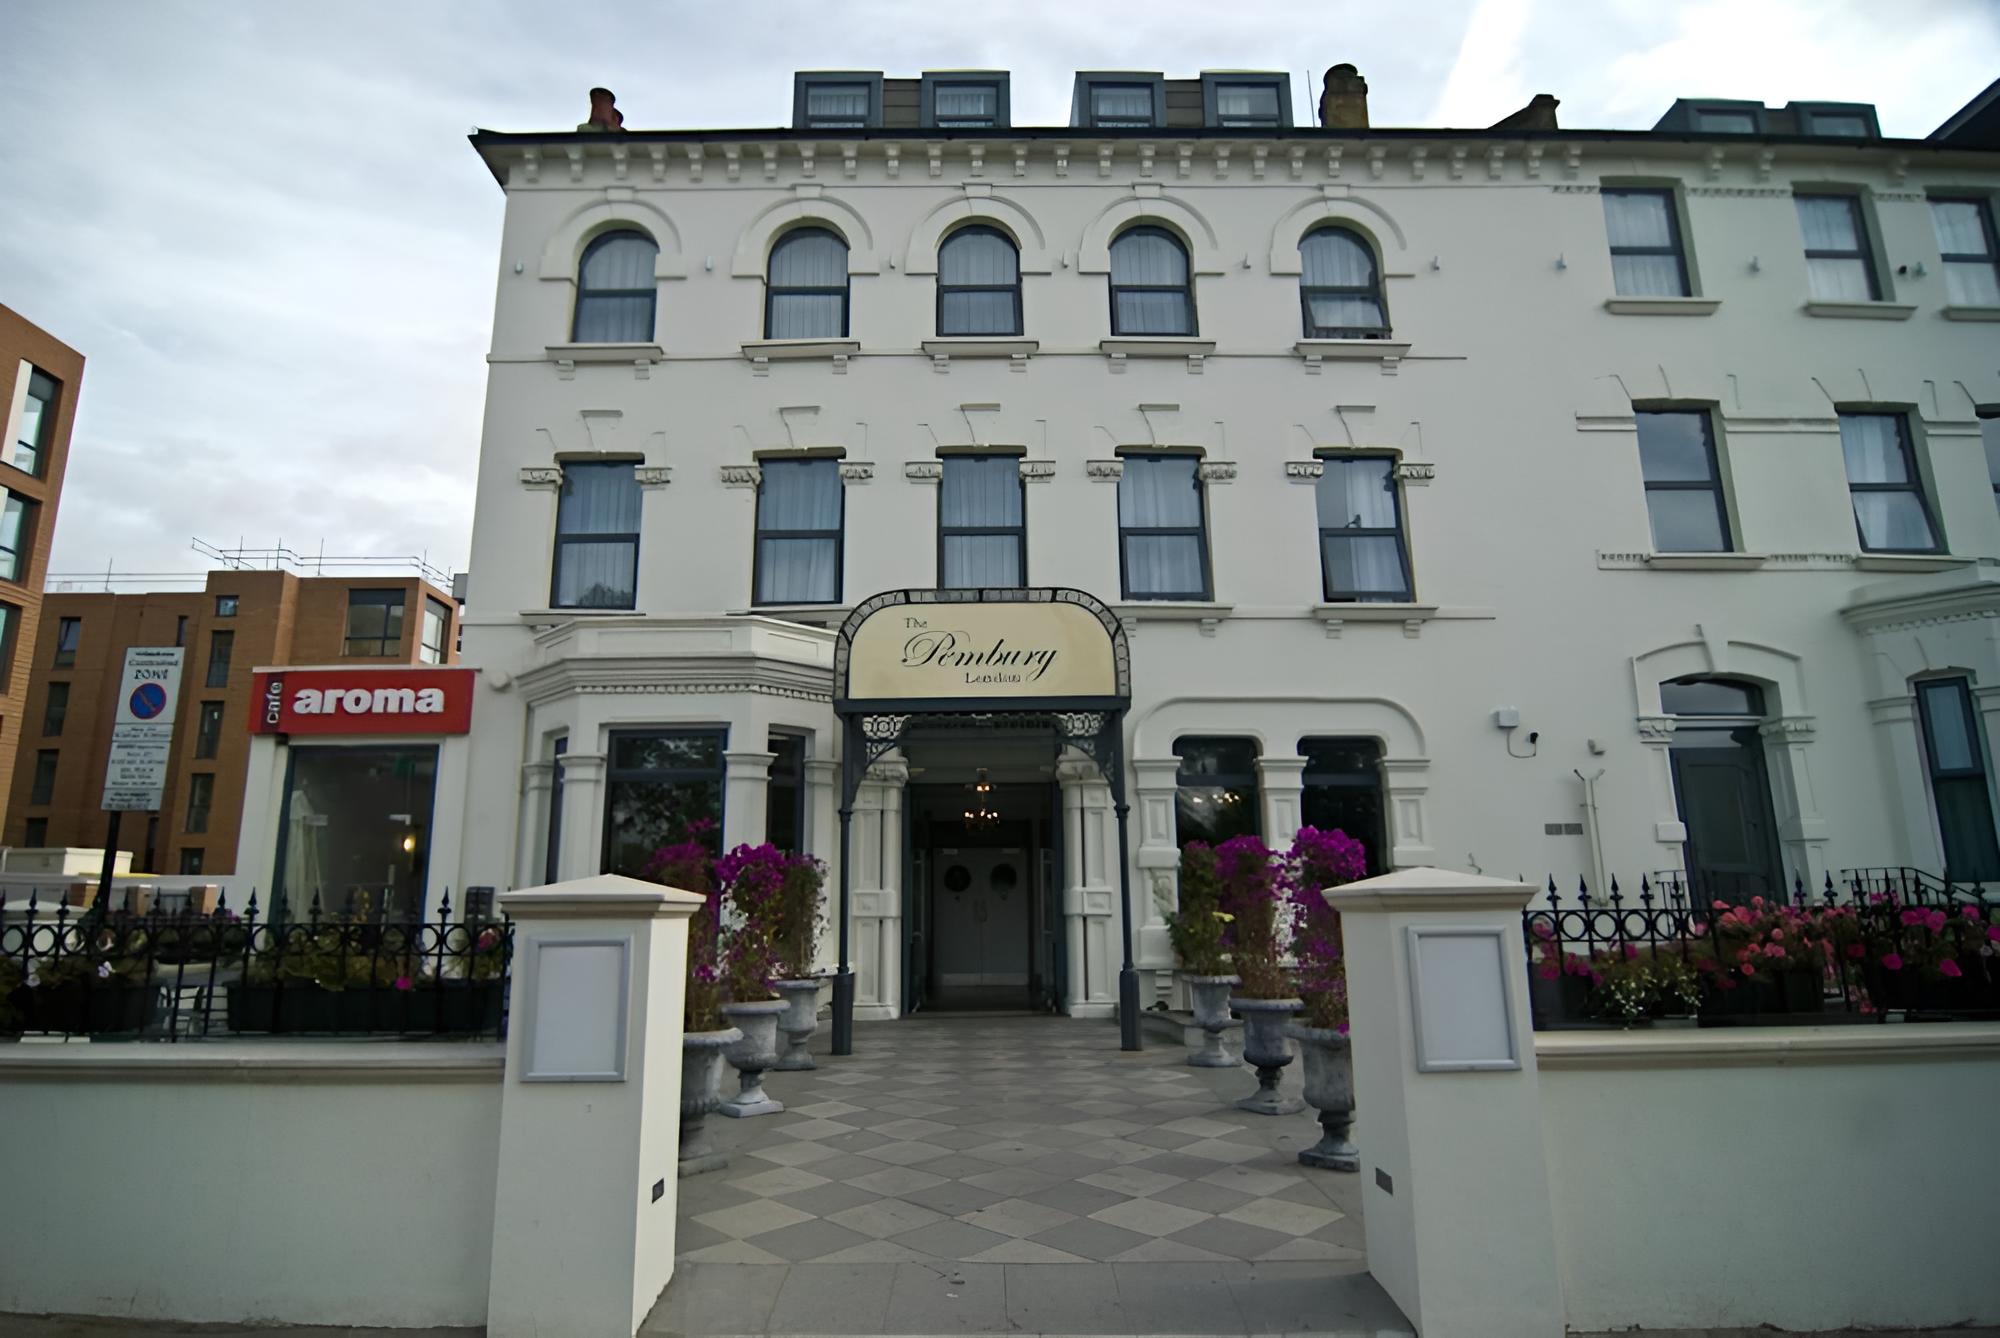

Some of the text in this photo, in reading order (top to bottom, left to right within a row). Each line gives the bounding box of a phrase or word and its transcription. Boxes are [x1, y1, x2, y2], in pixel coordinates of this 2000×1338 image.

[904, 617, 928, 628] The
[901, 630, 1057, 682] Pembury
[293, 687, 445, 714] aroma
